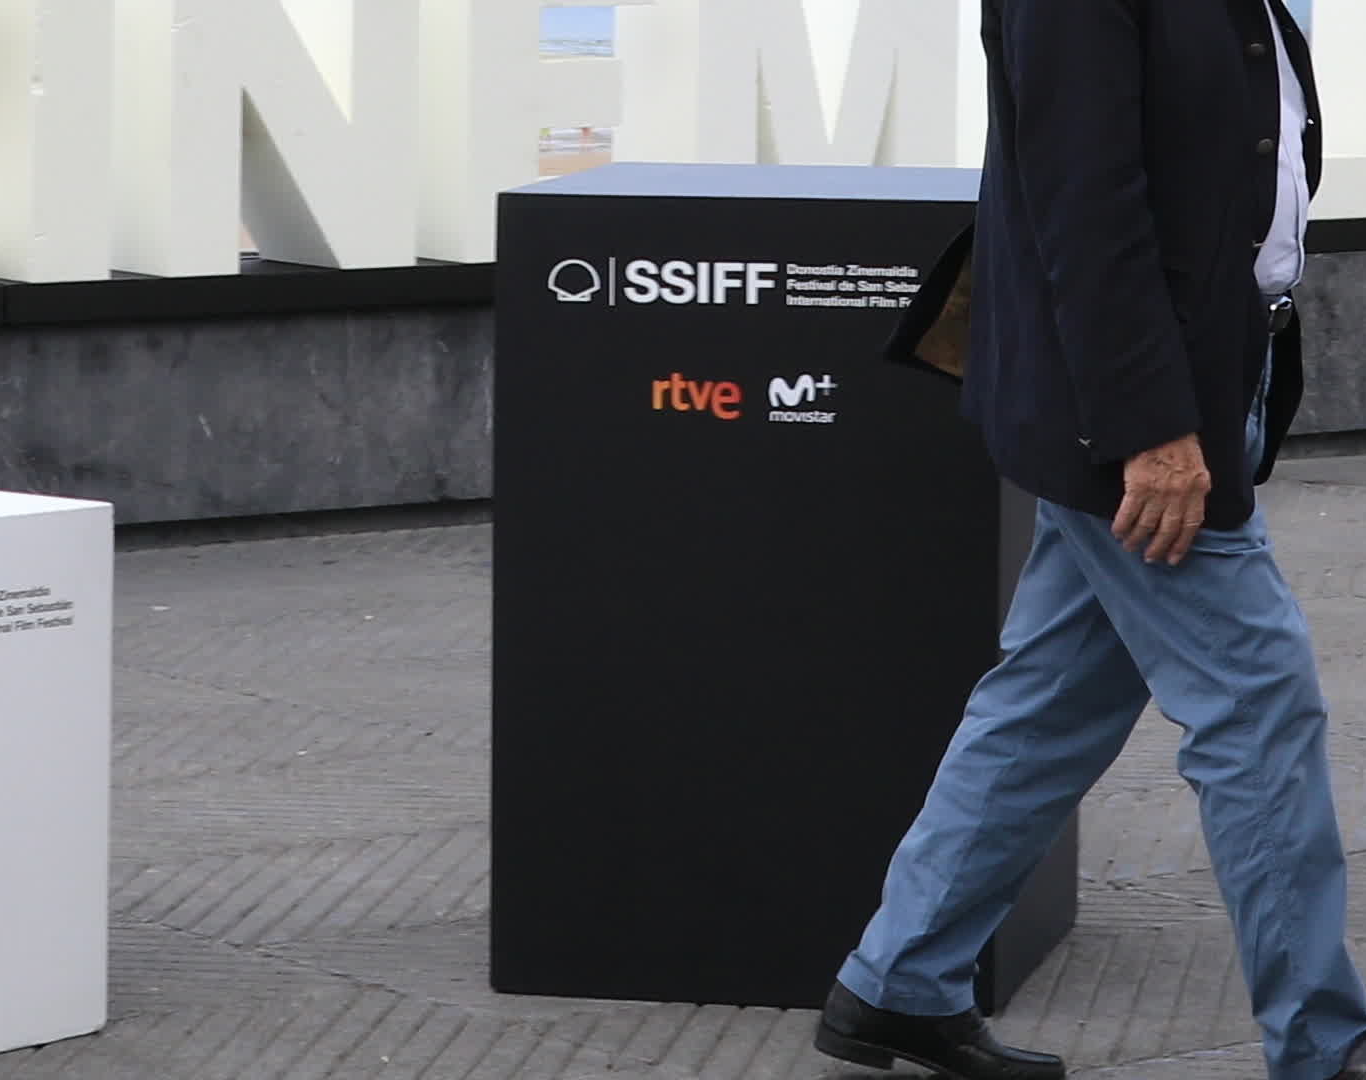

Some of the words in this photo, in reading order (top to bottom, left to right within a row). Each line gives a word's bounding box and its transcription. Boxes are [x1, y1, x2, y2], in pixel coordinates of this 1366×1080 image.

[623, 259, 778, 305] SSIFF
[786, 279, 837, 291] Festival
[837, 280, 856, 291] de
[857, 280, 884, 292] San
[786, 294, 868, 307] International
[868, 296, 897, 307] Film
[651, 372, 742, 419] rtve
[768, 410, 836, 423] movistar
